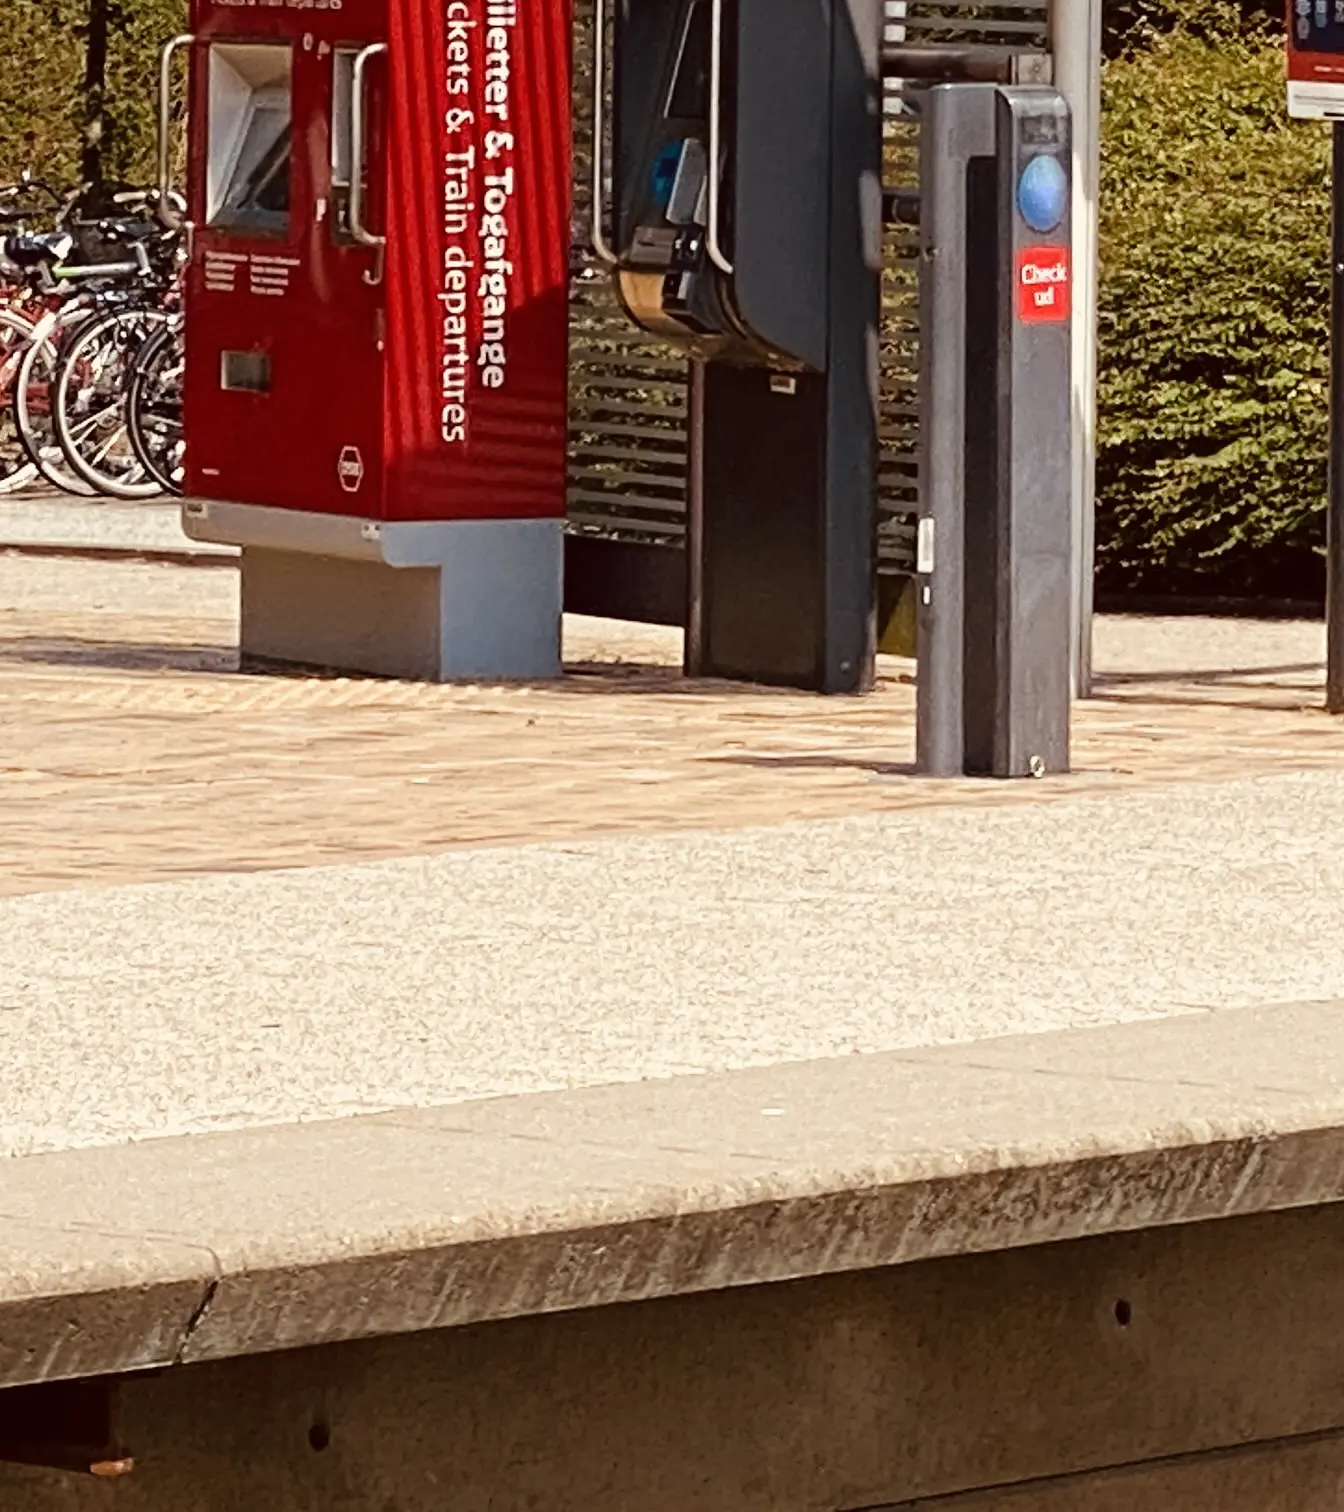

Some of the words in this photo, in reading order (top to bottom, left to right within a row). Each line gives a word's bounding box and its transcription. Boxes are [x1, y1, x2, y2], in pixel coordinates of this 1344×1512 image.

[445, 108, 474, 134] &
[484, 131, 514, 160] &
[444, 145, 475, 234] Train
[477, 167, 514, 388] Togafgange
[1022, 263, 1067, 285] Check
[437, 246, 474, 442] departures
